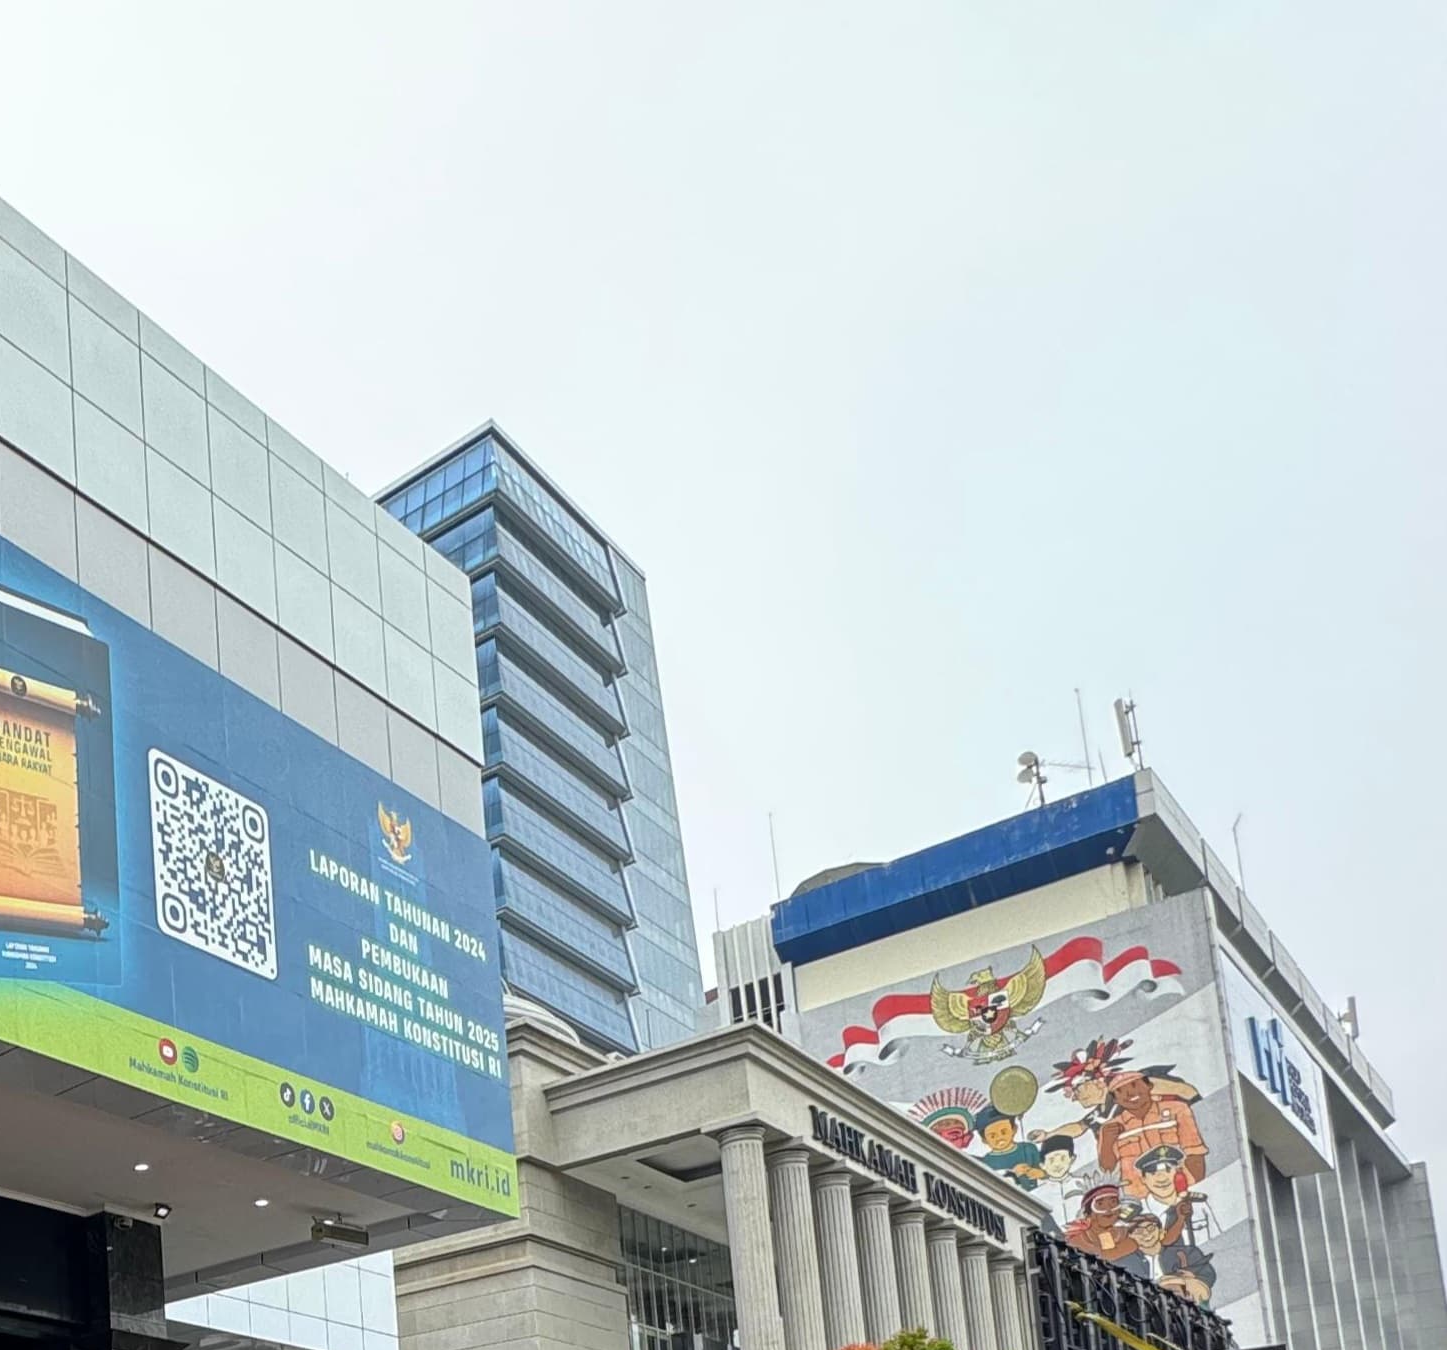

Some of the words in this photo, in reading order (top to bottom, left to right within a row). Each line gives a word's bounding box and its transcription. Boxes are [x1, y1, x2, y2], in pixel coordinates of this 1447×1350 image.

[21, 757, 52, 776] RAKYAT
[309, 848, 380, 905] LAPORAN
[384, 890, 451, 943] TAHUNAN
[453, 929, 486, 962] 2024
[389, 922, 419, 955] DAN
[308, 944, 353, 985] MASA
[358, 968, 413, 1012] SIDANG
[417, 996, 464, 1036] TAHUN
[467, 1021, 500, 1054] 2025
[361, 938, 449, 999] PEMBUKAAN
[310, 976, 399, 1034] MAHKAMAH
[403, 1017, 485, 1073] KONSTITUSI
[488, 1056, 502, 1079] RI
[450, 1157, 512, 1197] mkri.id
[809, 1105, 919, 1195] MAHKAMAH
[924, 1171, 1009, 1244] KONSTITUSI
